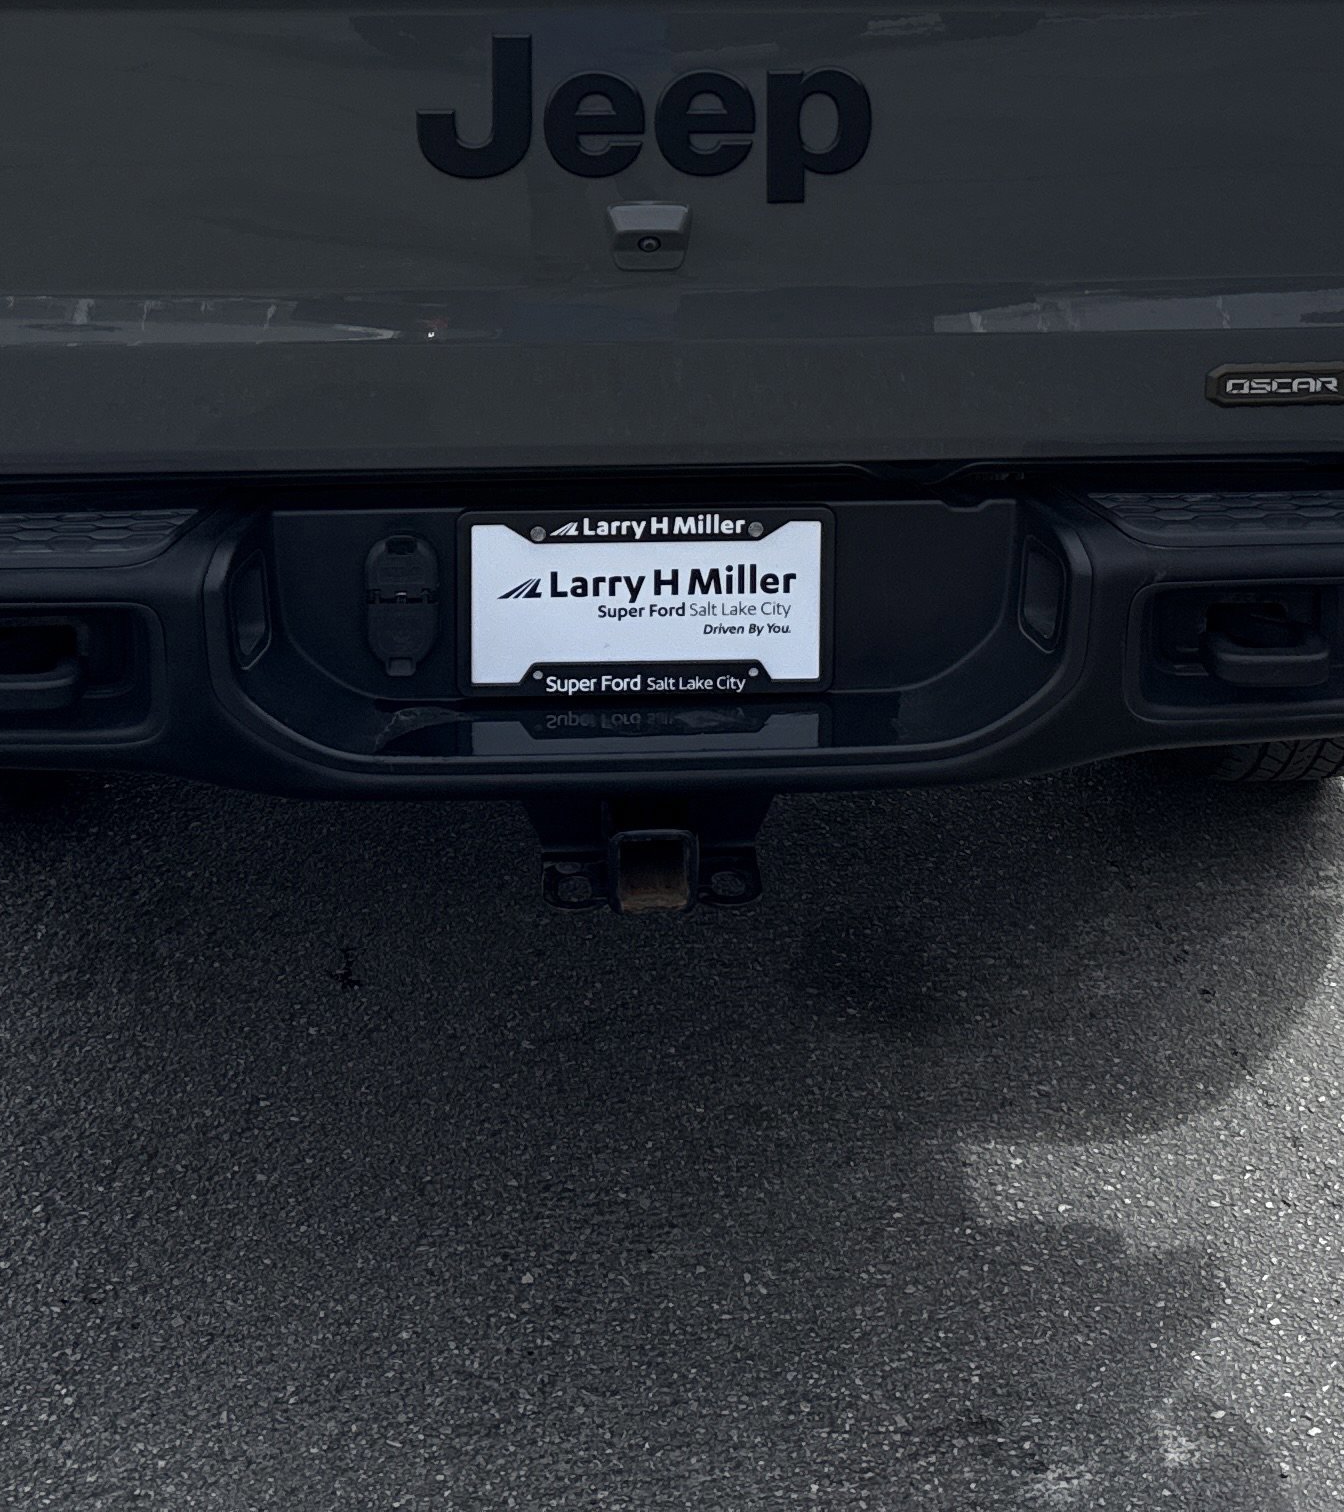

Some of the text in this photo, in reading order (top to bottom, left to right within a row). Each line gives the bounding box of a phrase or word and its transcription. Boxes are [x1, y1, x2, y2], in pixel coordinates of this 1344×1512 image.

[416, 33, 872, 204] Jeep
[1226, 377, 1338, 394] OSCAR
[583, 513, 745, 539] Larry H Miller
[550, 564, 796, 603] Larry H Miller
[597, 601, 792, 621] Super Ford Salt Lake City
[703, 623, 792, 636] Driven By You.
[546, 674, 746, 696] Super Ford Salt Lake City
